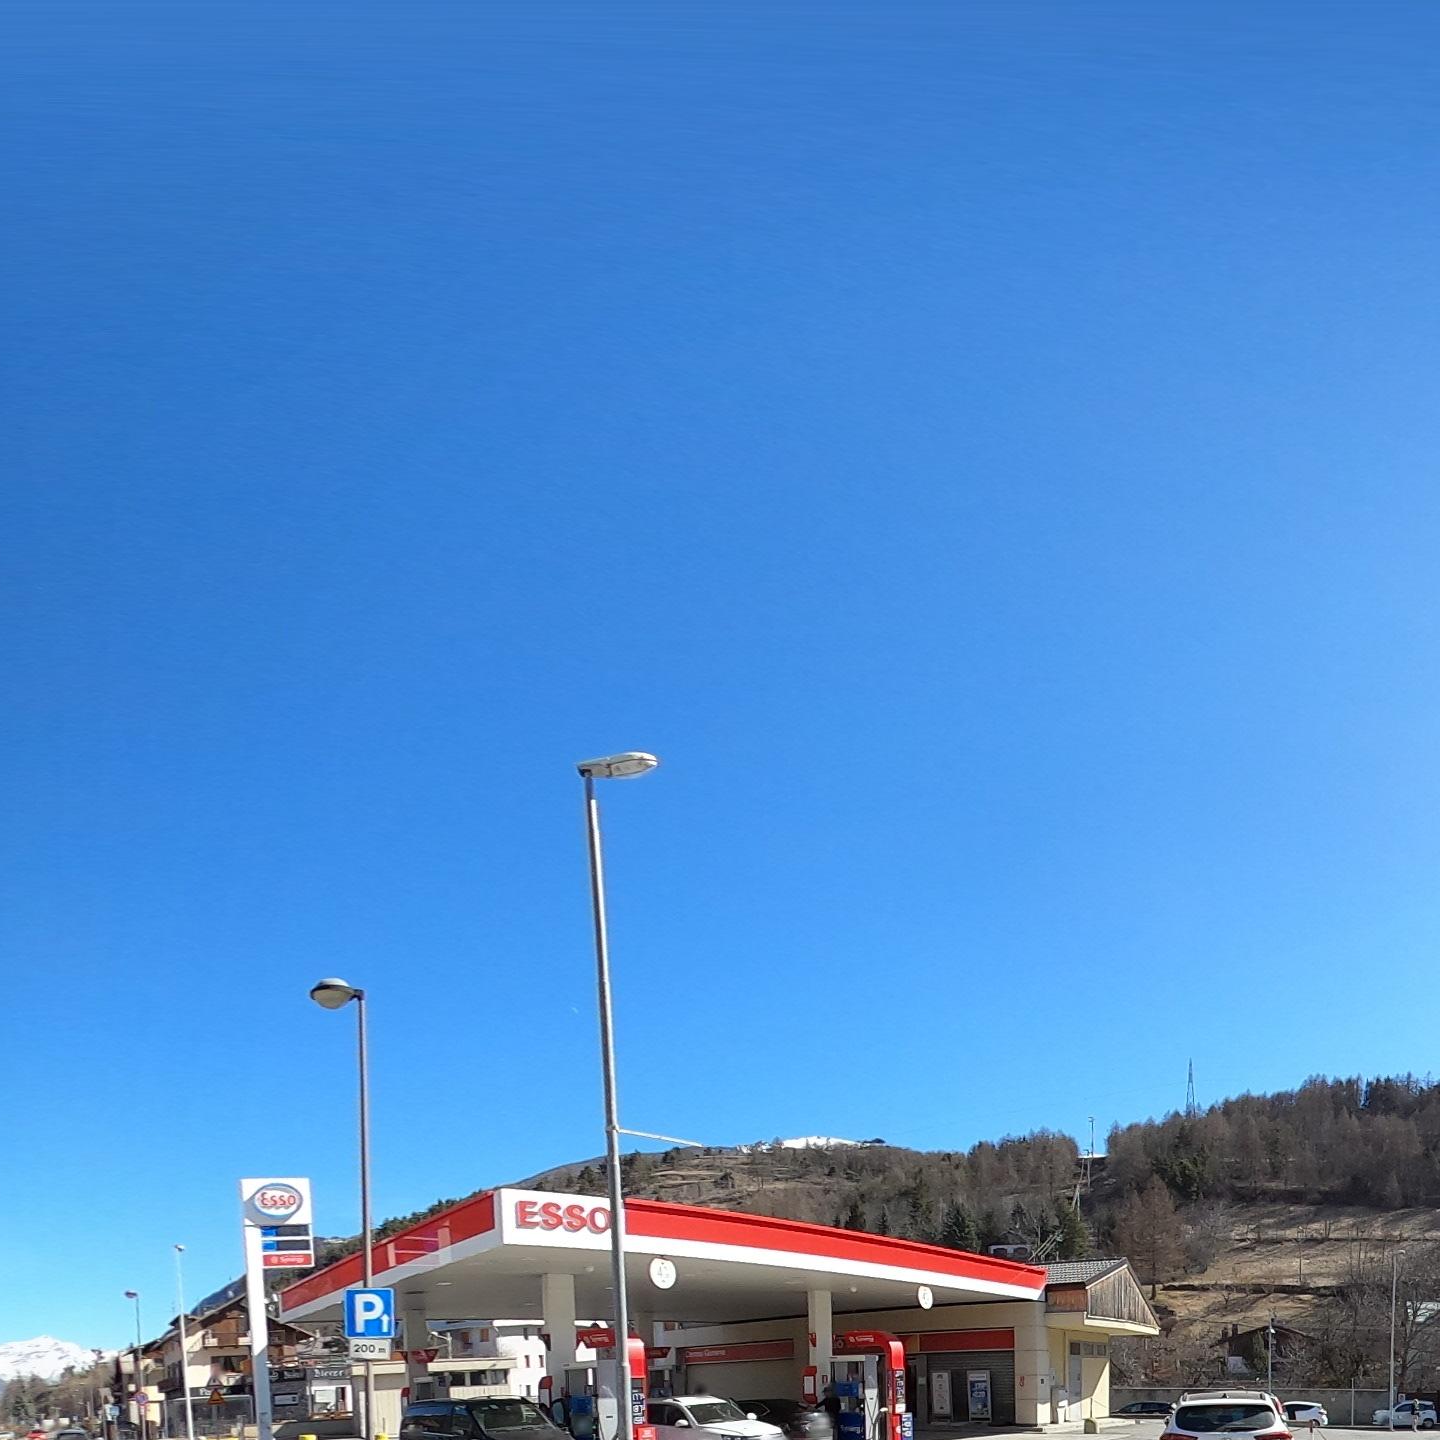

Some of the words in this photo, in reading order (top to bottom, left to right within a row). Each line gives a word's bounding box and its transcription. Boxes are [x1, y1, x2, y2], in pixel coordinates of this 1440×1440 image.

[515, 1200, 611, 1234] ESSO
[355, 1293, 385, 1333] P
[353, 1343, 376, 1353] 200
